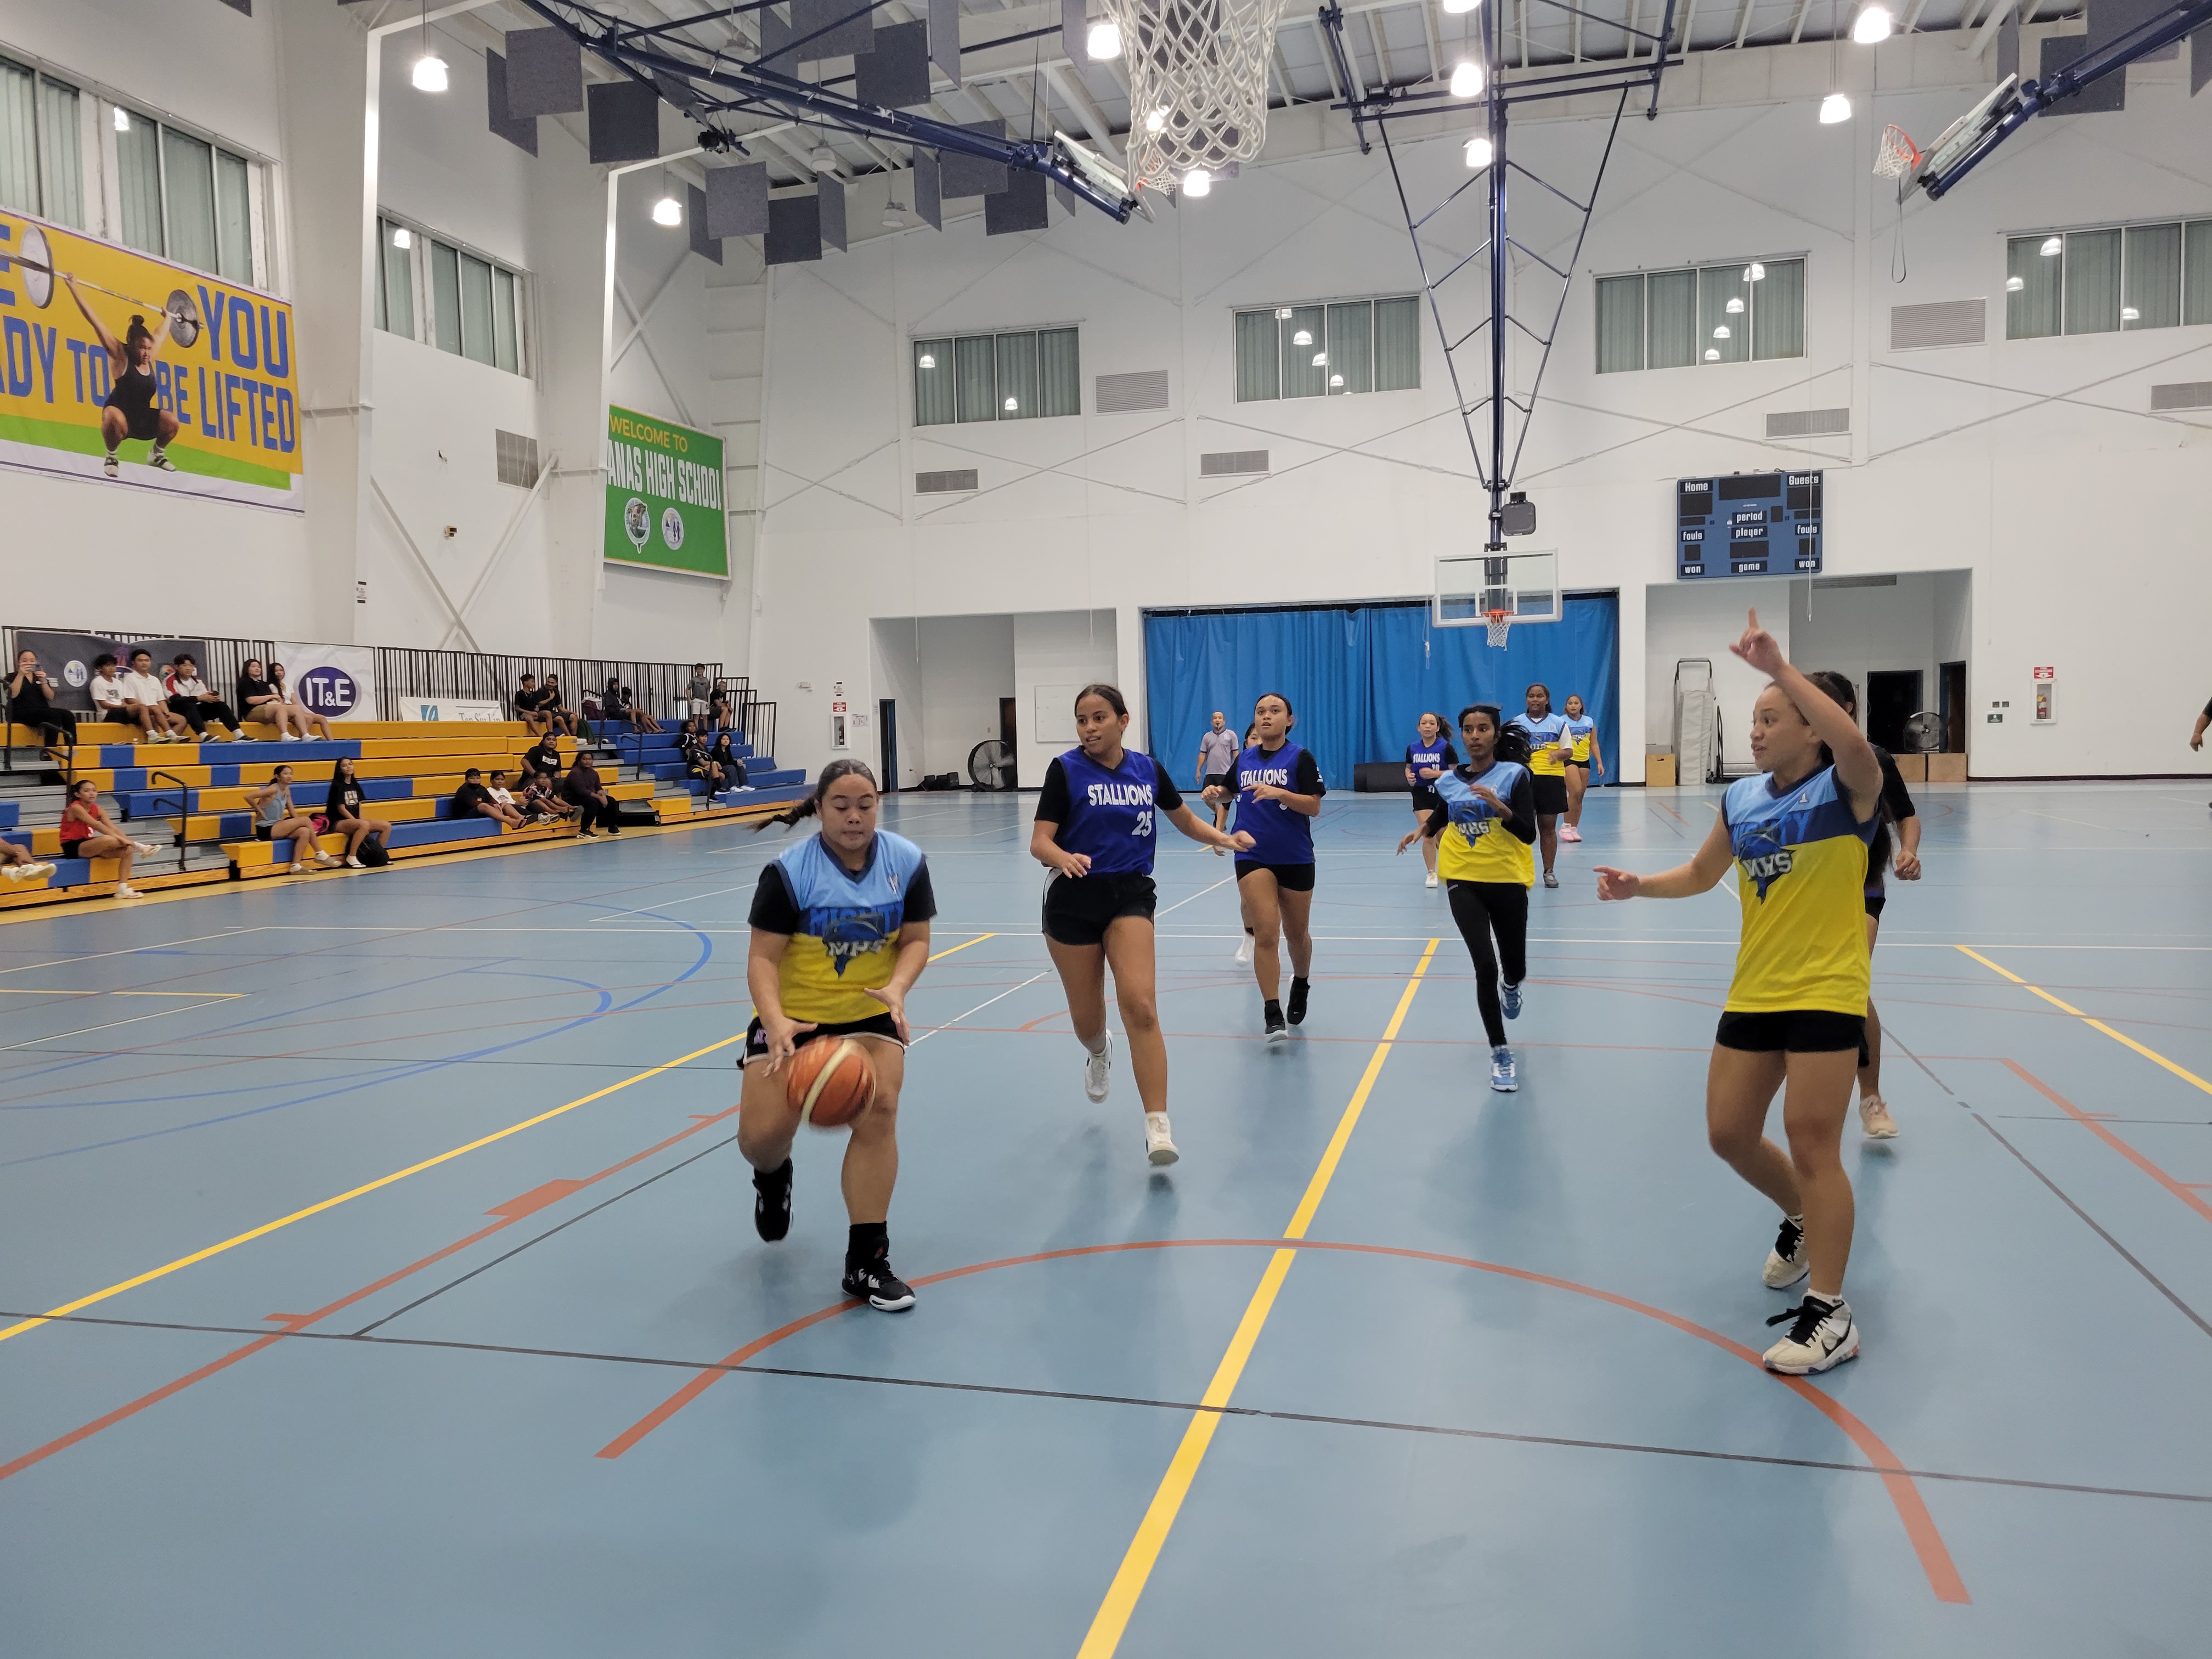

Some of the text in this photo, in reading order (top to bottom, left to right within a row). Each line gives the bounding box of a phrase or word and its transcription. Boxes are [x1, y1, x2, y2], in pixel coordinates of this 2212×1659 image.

[197, 285, 289, 377] YOU
[0, 315, 295, 454] DY TO BE LIFTED
[610, 414, 688, 453] WELCOME TO
[645, 449, 675, 500] HIGH
[678, 459, 721, 511] SCHOOL
[1788, 475, 1819, 486] Guests
[1685, 482, 1708, 492] Home
[1736, 511, 1763, 523] period
[1683, 531, 1703, 540] fouls
[1736, 527, 1763, 539] player
[1685, 565, 1701, 574] won
[1739, 562, 1760, 573] game
[1799, 560, 1815, 568] won
[306, 677, 352, 707] IT&E
[1413, 753, 1440, 763] STALLIONS
[1240, 769, 1288, 787] STALLIONS
[1087, 783, 1152, 806] STALLIONS
[1131, 811, 1152, 837] 25
